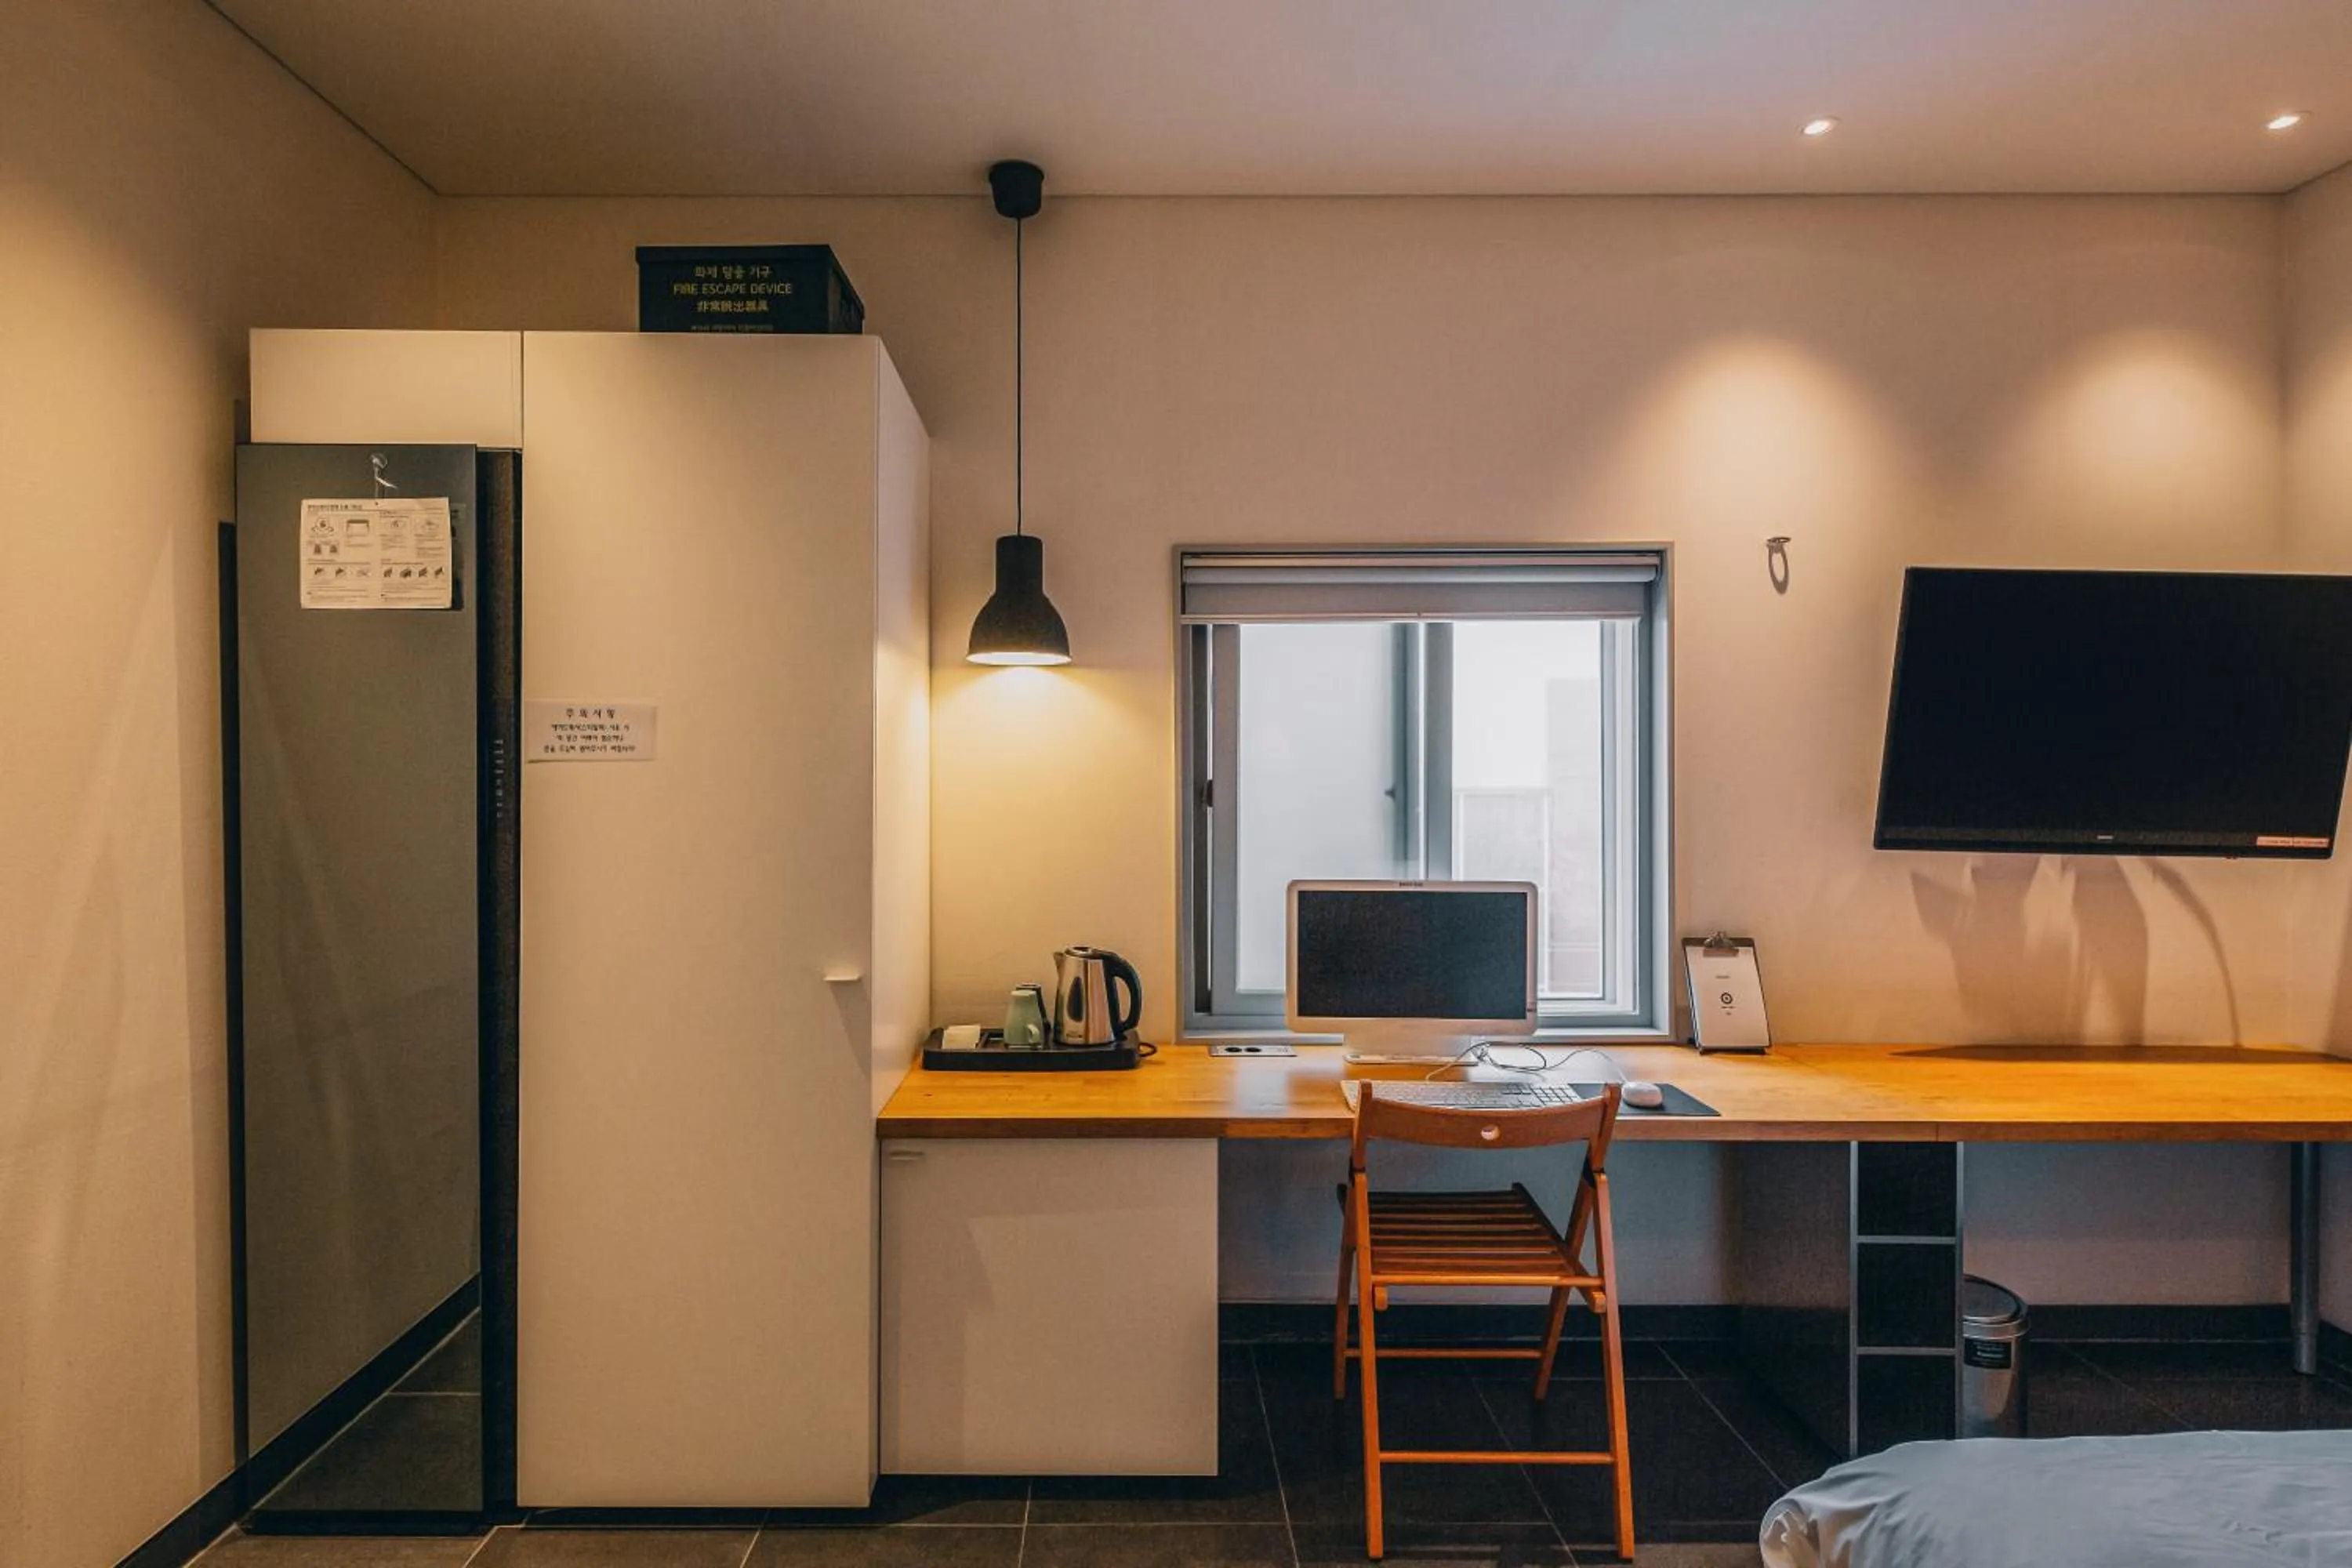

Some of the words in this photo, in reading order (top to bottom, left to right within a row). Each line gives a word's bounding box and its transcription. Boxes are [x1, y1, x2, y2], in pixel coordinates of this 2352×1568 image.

[673, 282, 699, 296] FIRE
[702, 282, 746, 295] ESCAPE
[750, 282, 793, 296] DEVICE
